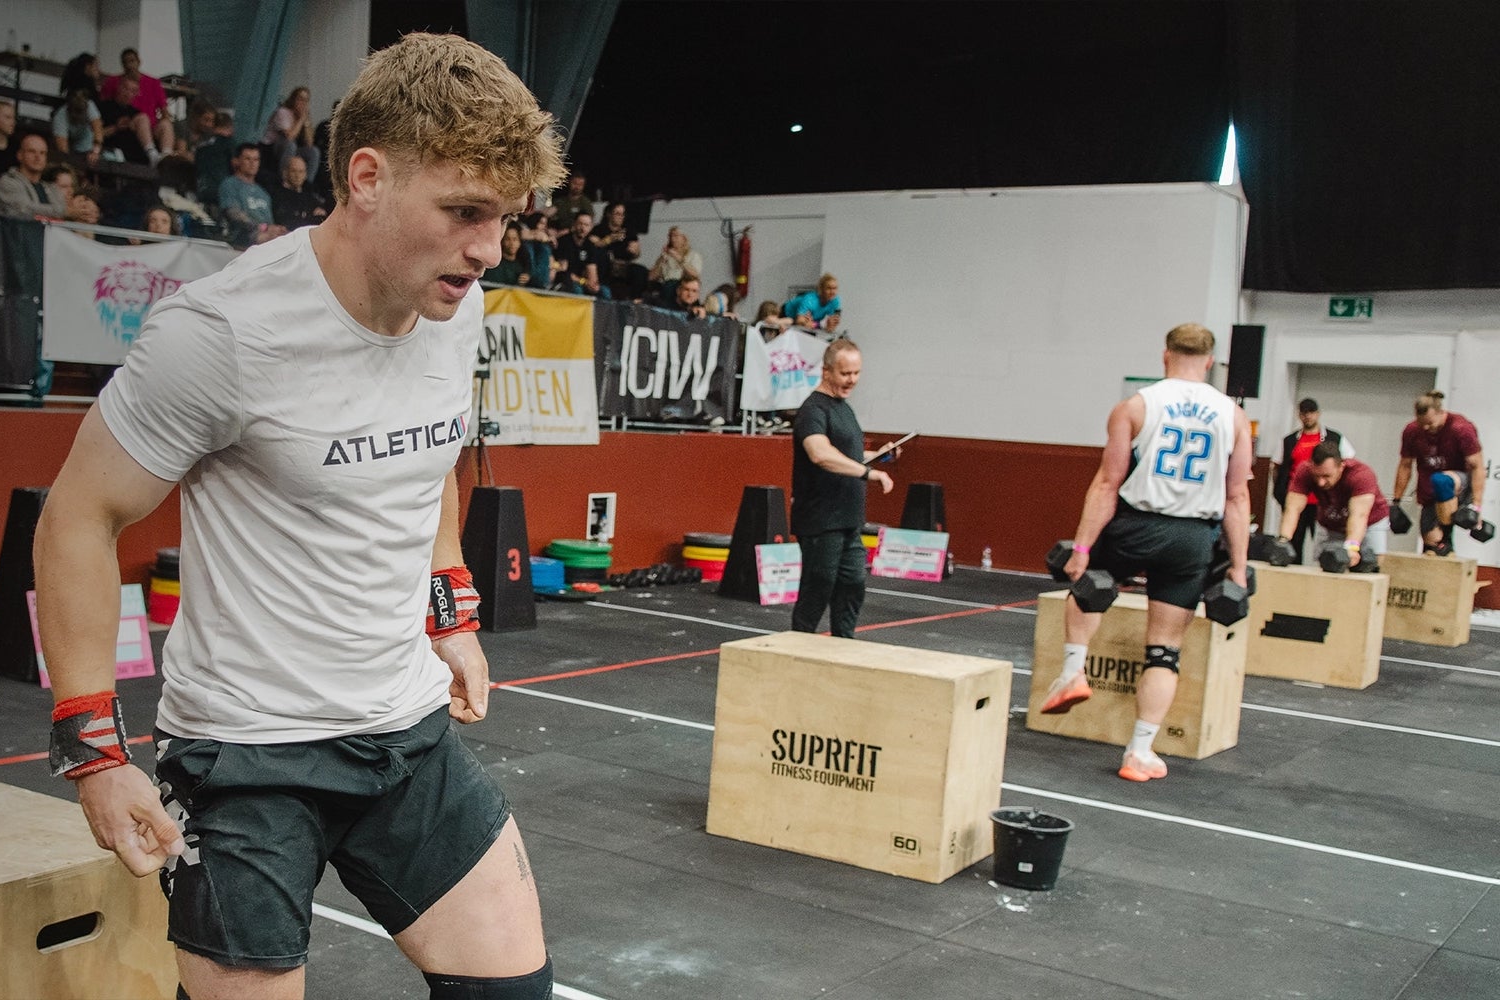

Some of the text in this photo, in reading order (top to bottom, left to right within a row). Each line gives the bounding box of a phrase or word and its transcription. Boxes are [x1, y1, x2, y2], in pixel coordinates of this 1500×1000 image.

[618, 325, 720, 400] ICIW
[322, 415, 467, 466] ATLETICA
[1153, 424, 1213, 484] 22
[507, 547, 521, 582] 3
[432, 576, 450, 625] ROGUE
[1084, 656, 1145, 683] UPRF
[771, 729, 882, 778] SUPRFIT
[771, 762, 875, 792] FITNESS EQUIPMENT
[894, 835, 917, 851] 60
